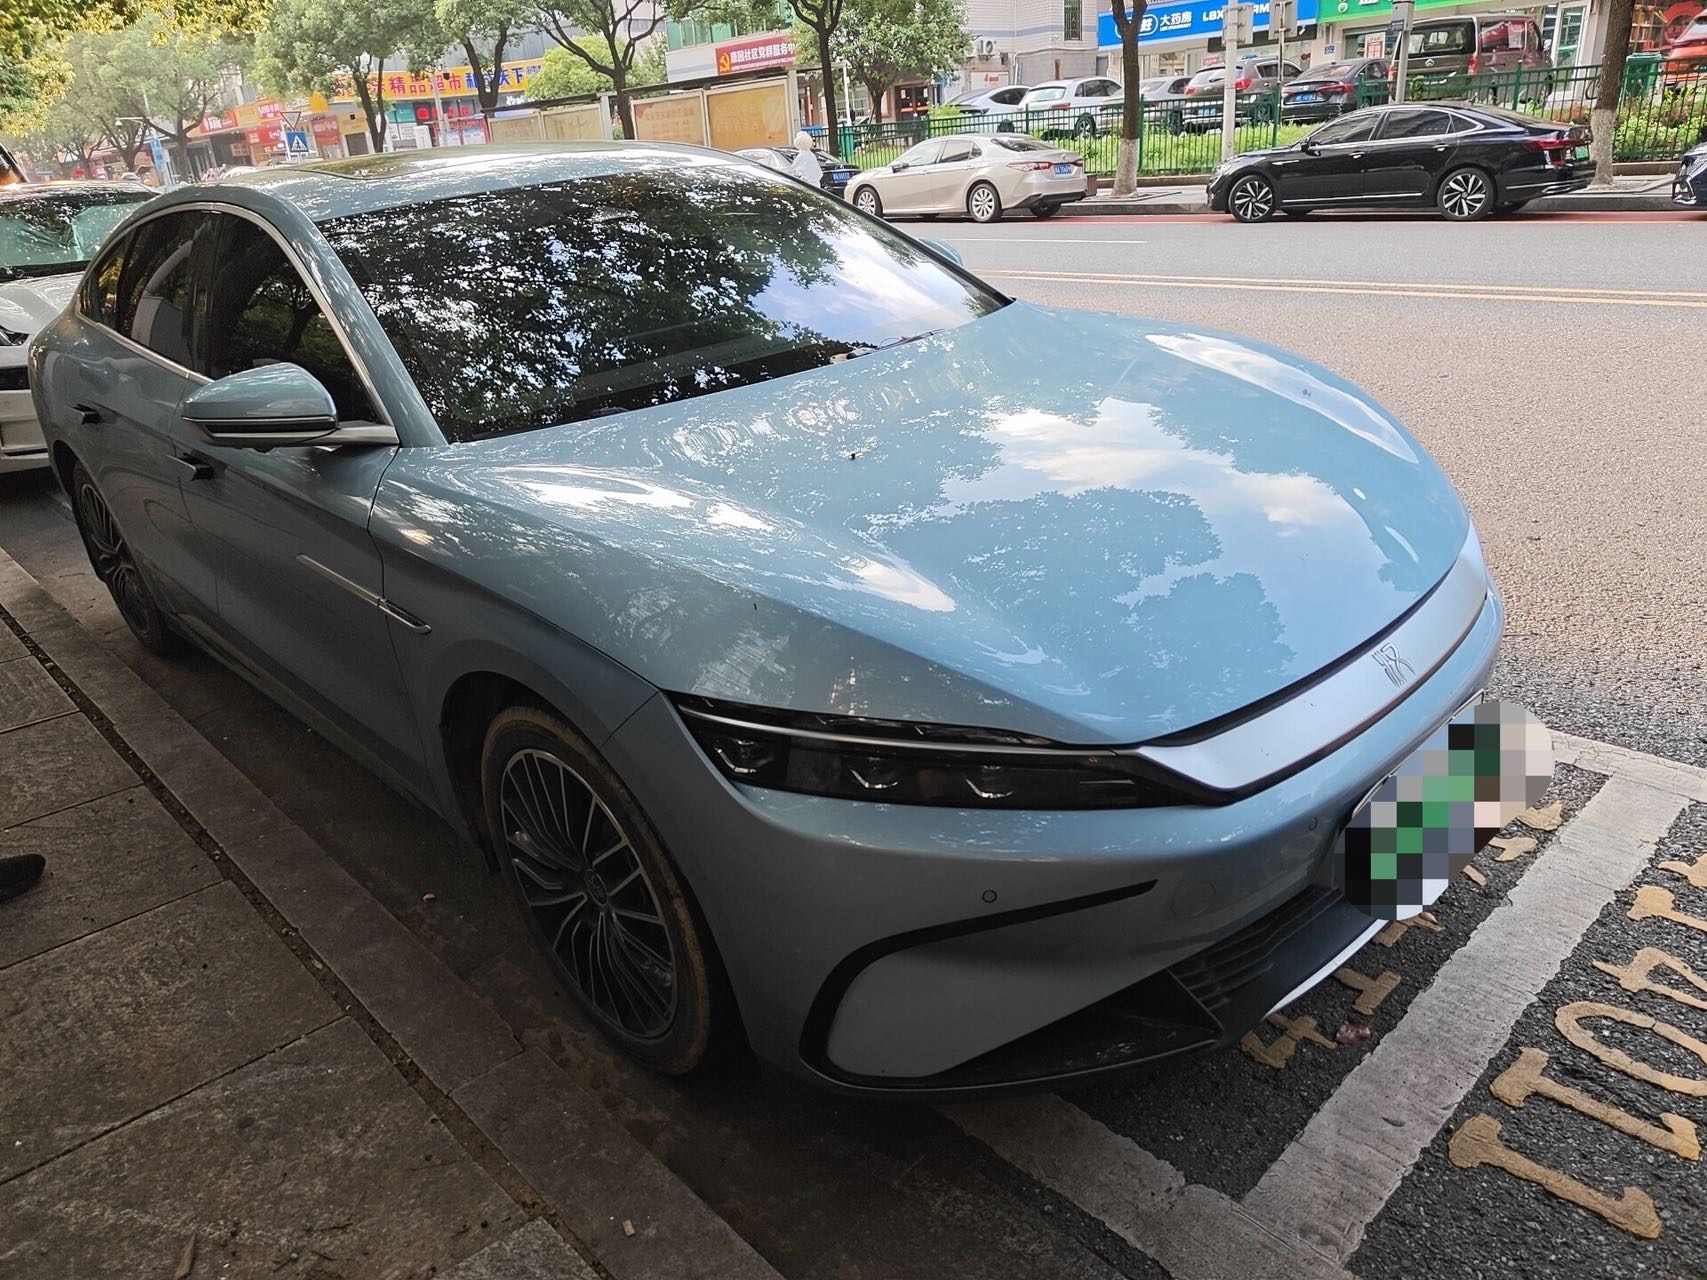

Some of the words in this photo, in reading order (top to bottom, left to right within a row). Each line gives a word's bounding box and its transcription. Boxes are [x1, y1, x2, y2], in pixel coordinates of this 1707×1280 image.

[1160, 11, 1192, 27] 大药房
[1203, 9, 1224, 22] LBX
[465, 67, 524, 89] 和天下
